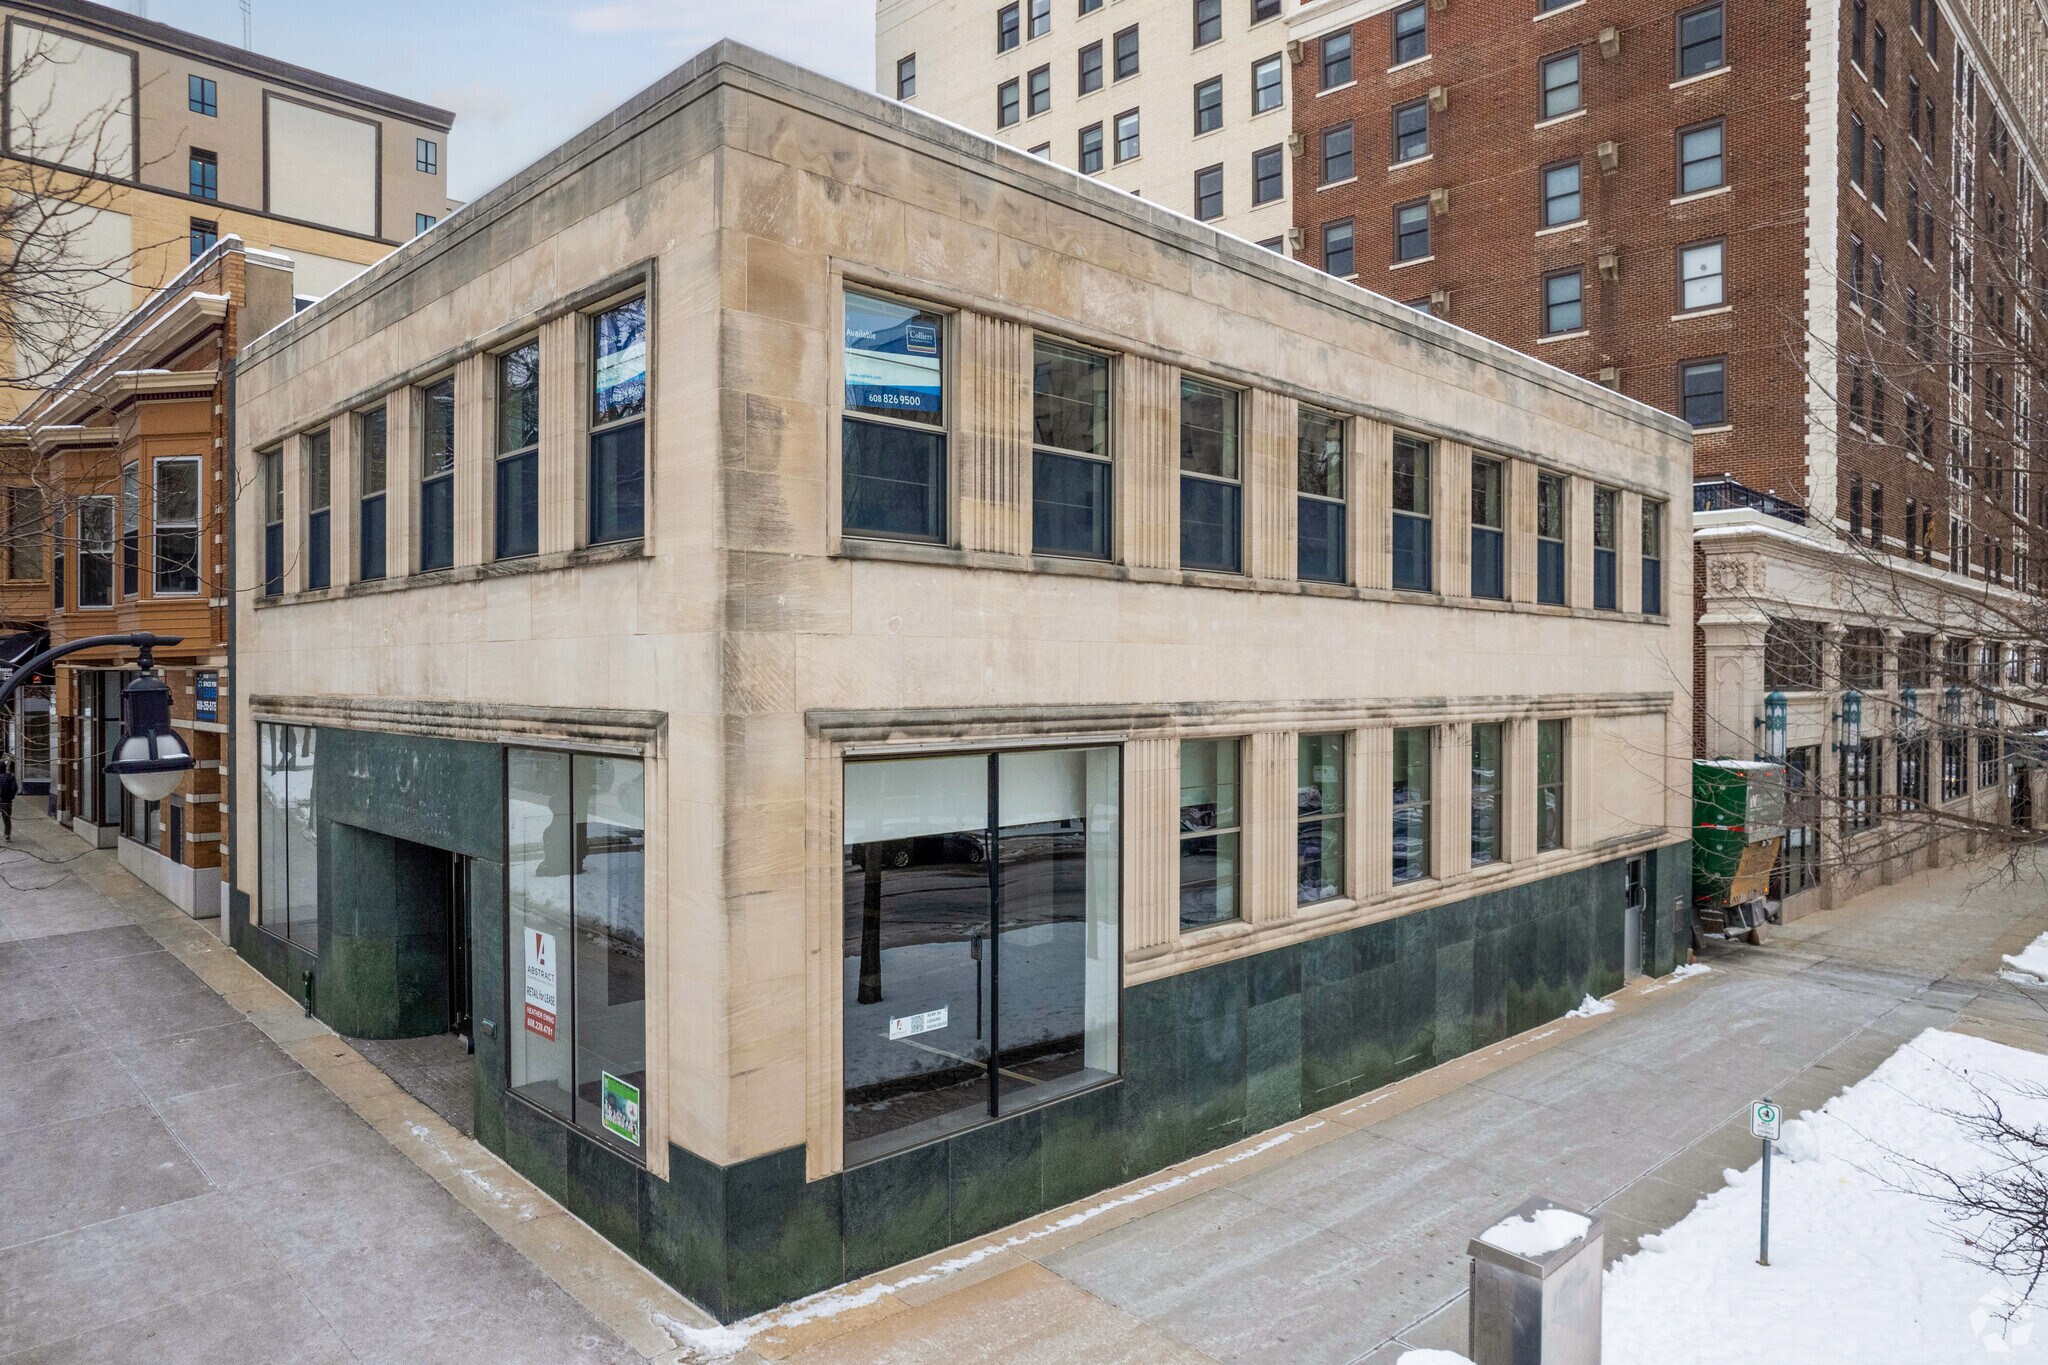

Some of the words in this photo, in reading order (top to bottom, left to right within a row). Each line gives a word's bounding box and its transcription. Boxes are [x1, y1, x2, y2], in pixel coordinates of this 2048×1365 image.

[846, 328, 876, 340] Available
[910, 331, 932, 340] Colliers
[869, 394, 882, 403] 608
[883, 394, 899, 404] 826
[900, 396, 921, 406] 9500
[527, 965, 555, 983] ABSTRACT
[526, 986, 539, 1000] RETAIL
[544, 993, 555, 1007] LEASE
[526, 1006, 543, 1019] HEATHER
